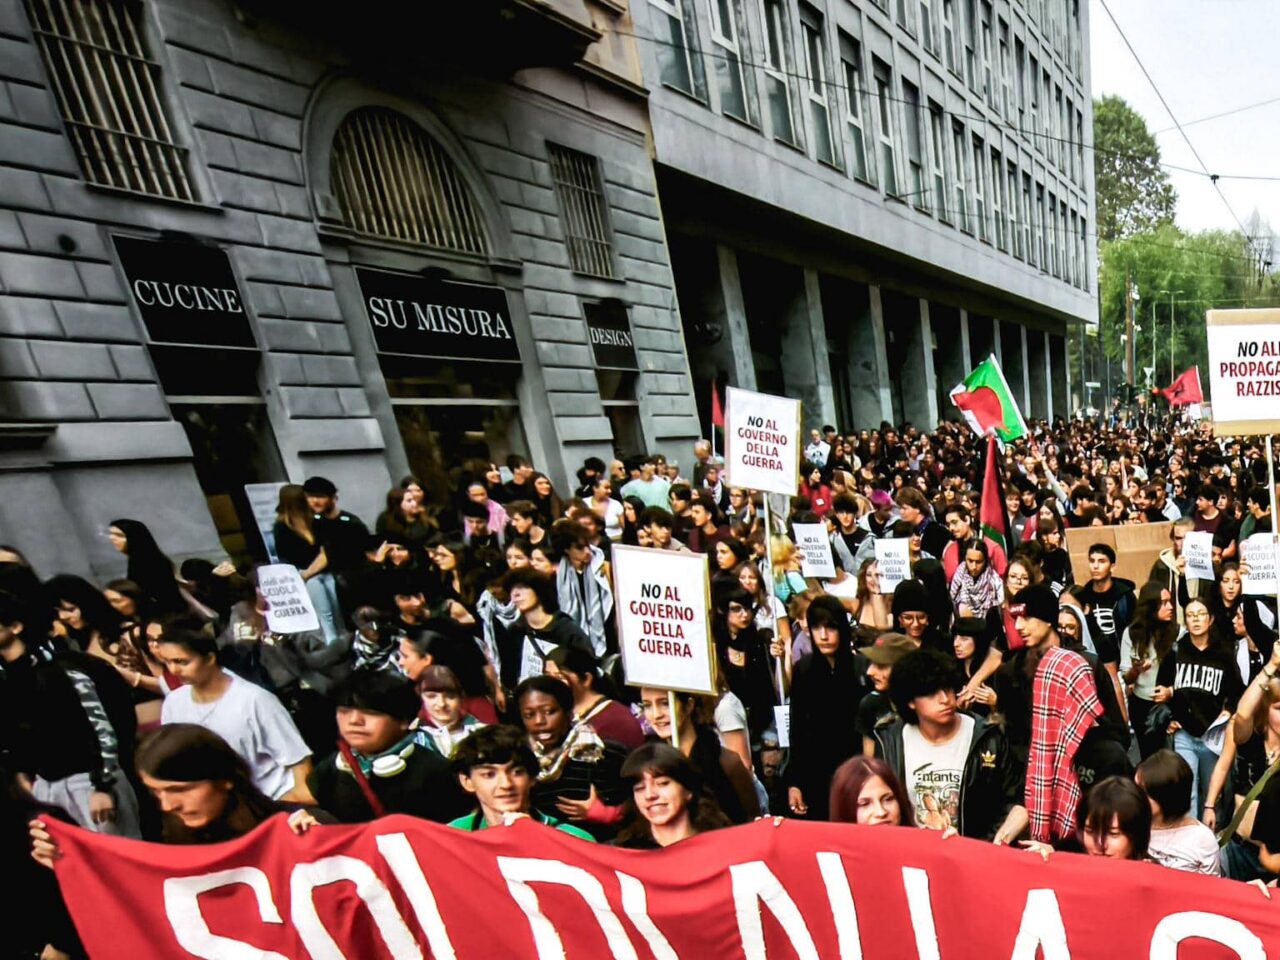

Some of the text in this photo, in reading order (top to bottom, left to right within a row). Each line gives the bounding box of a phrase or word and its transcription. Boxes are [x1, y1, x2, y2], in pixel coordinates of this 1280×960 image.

[134, 279, 243, 313] CUCINE
[369, 296, 512, 339] SU MISURA
[590, 327, 632, 347] DESIGN
[1237, 341, 1258, 358] NO
[747, 415, 779, 431] NO AL
[737, 427, 788, 446] GOVERNO
[746, 442, 779, 458] DELLA
[742, 454, 784, 471] GUERRA
[641, 583, 681, 601] NO AL
[274, 606, 309, 618] GUERRA
[630, 600, 694, 621] GOVERNO
[642, 620, 684, 639] DELLA
[638, 638, 692, 658] GUERRA
[1174, 662, 1223, 696] MALIBU
